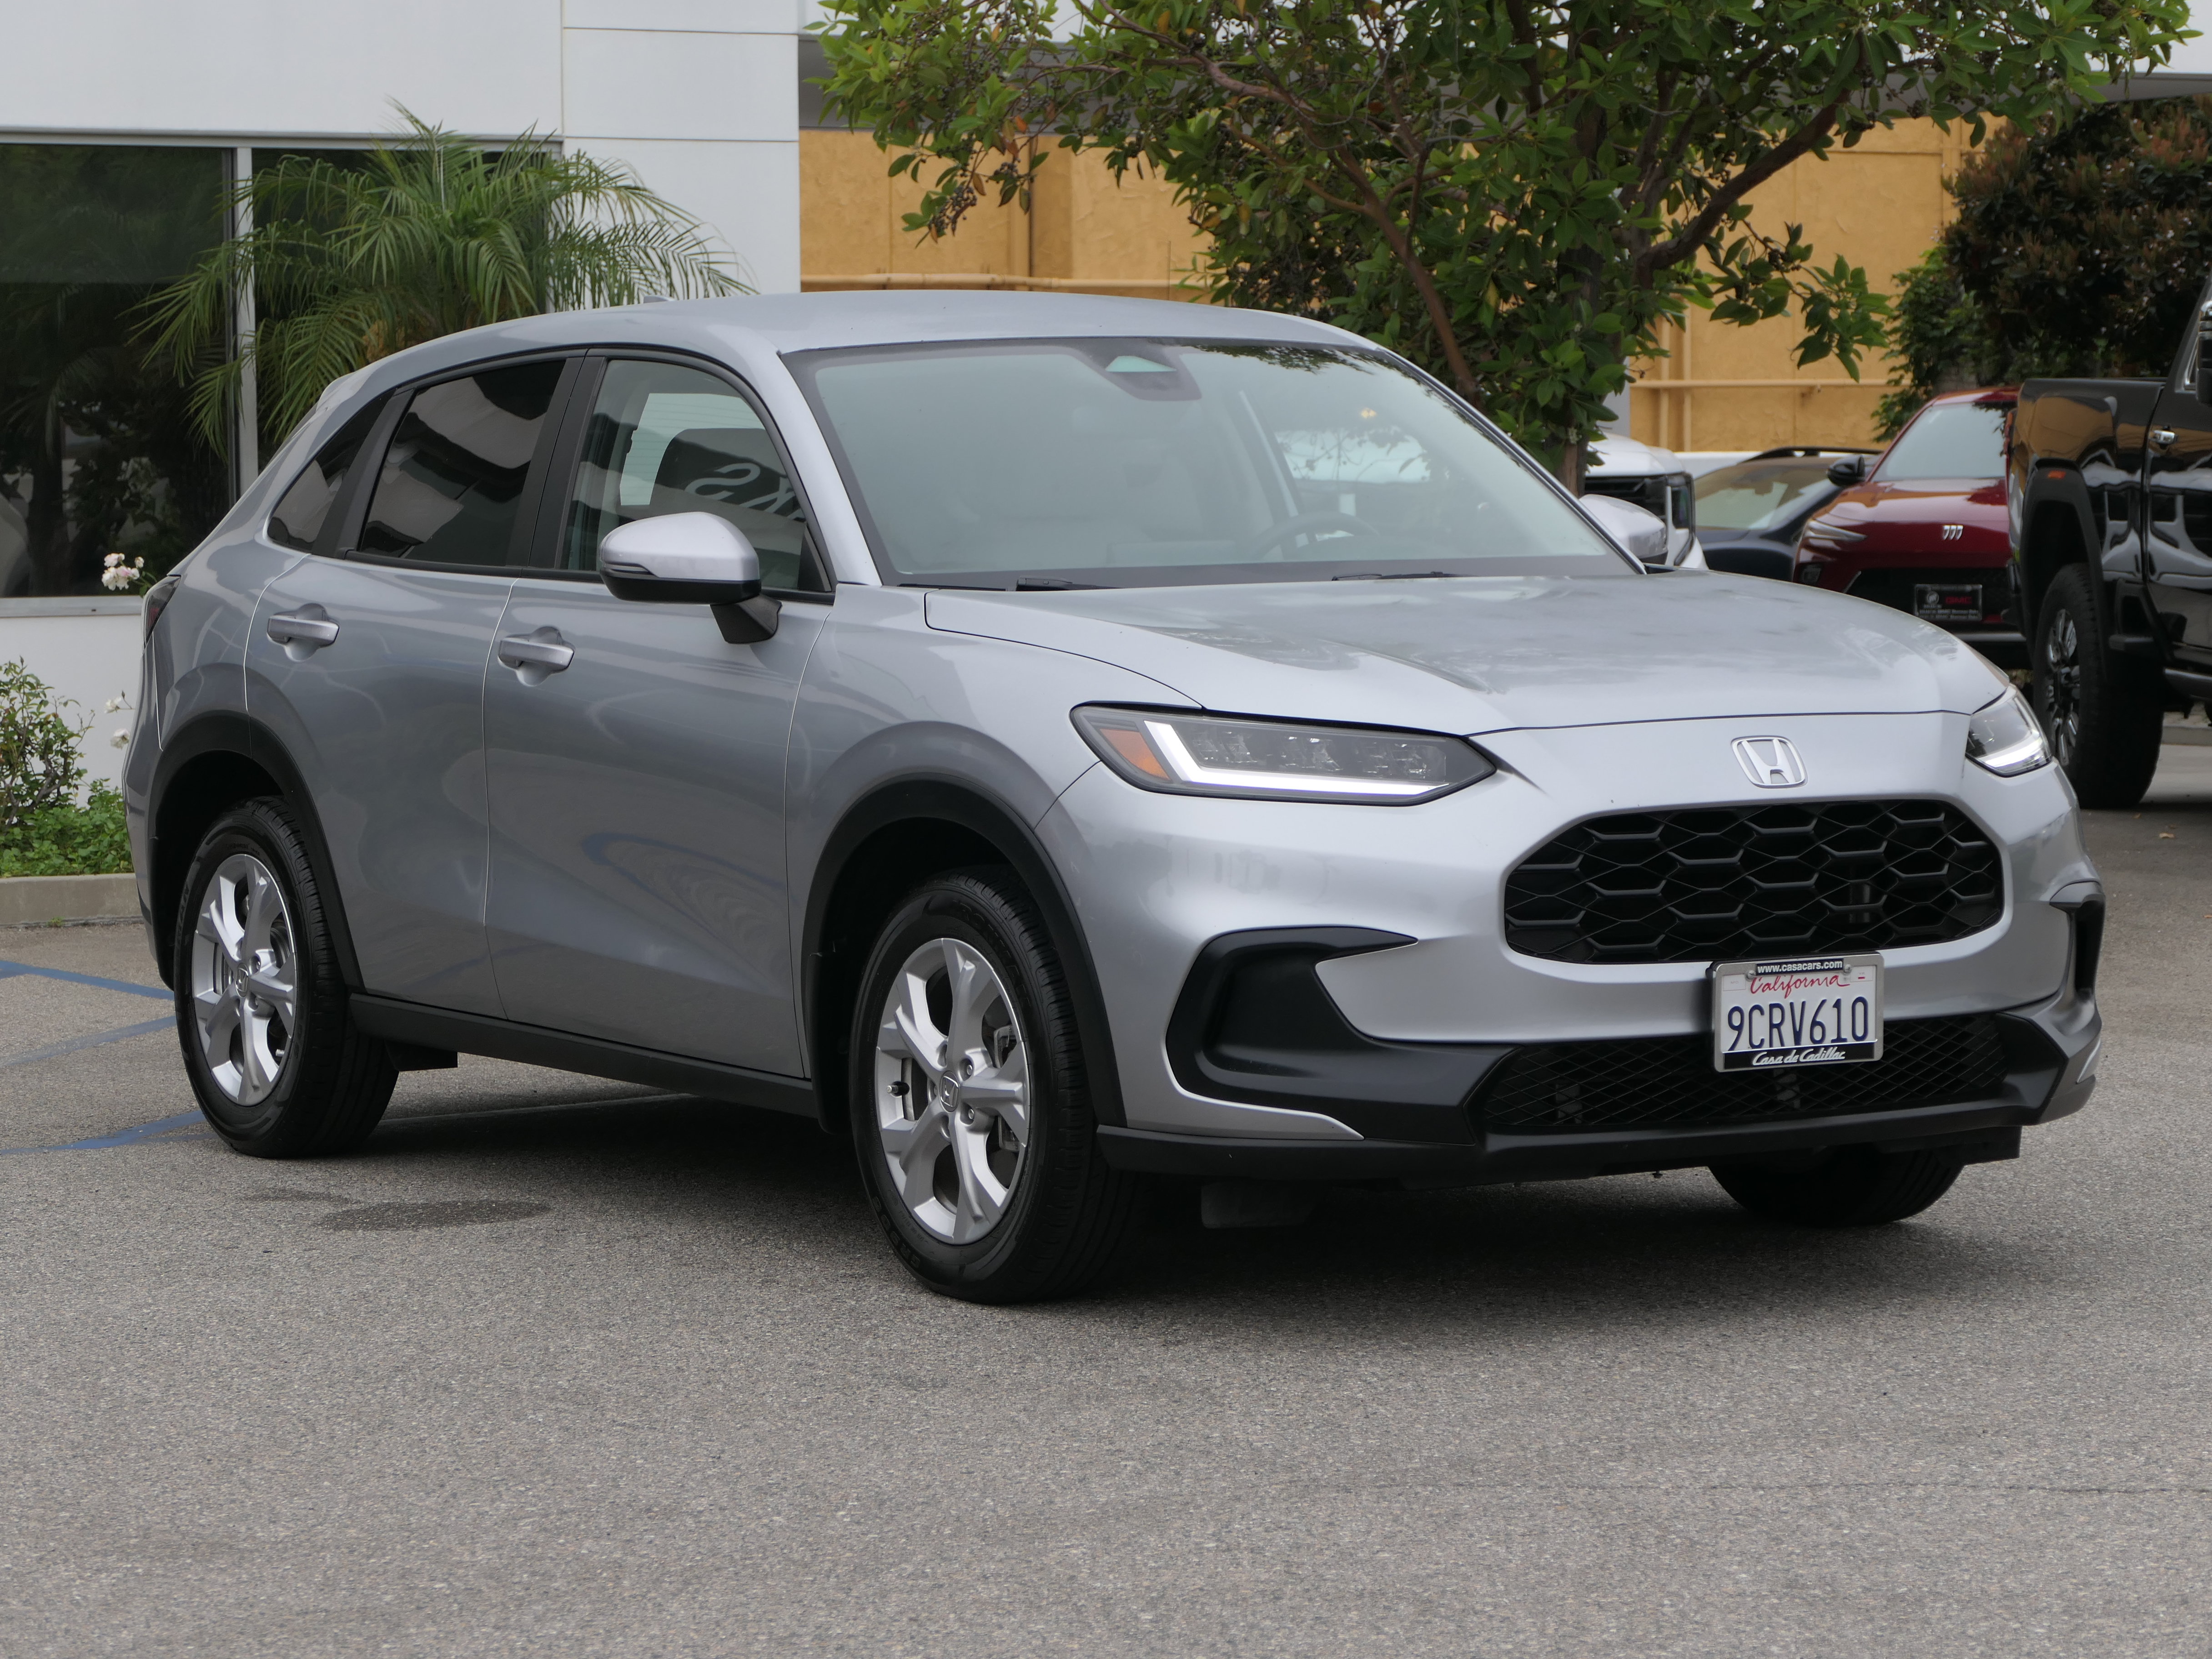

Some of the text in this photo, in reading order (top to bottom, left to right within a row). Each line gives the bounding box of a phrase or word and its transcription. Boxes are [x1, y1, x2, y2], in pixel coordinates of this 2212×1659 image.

[1945, 596, 1972, 604] GMC
[1757, 960, 1843, 974] www.casacars.com
[1750, 975, 1850, 999] California
[1728, 996, 1869, 1051] 9CRV610
[1753, 1047, 1845, 1066] Casa de Cadillac
